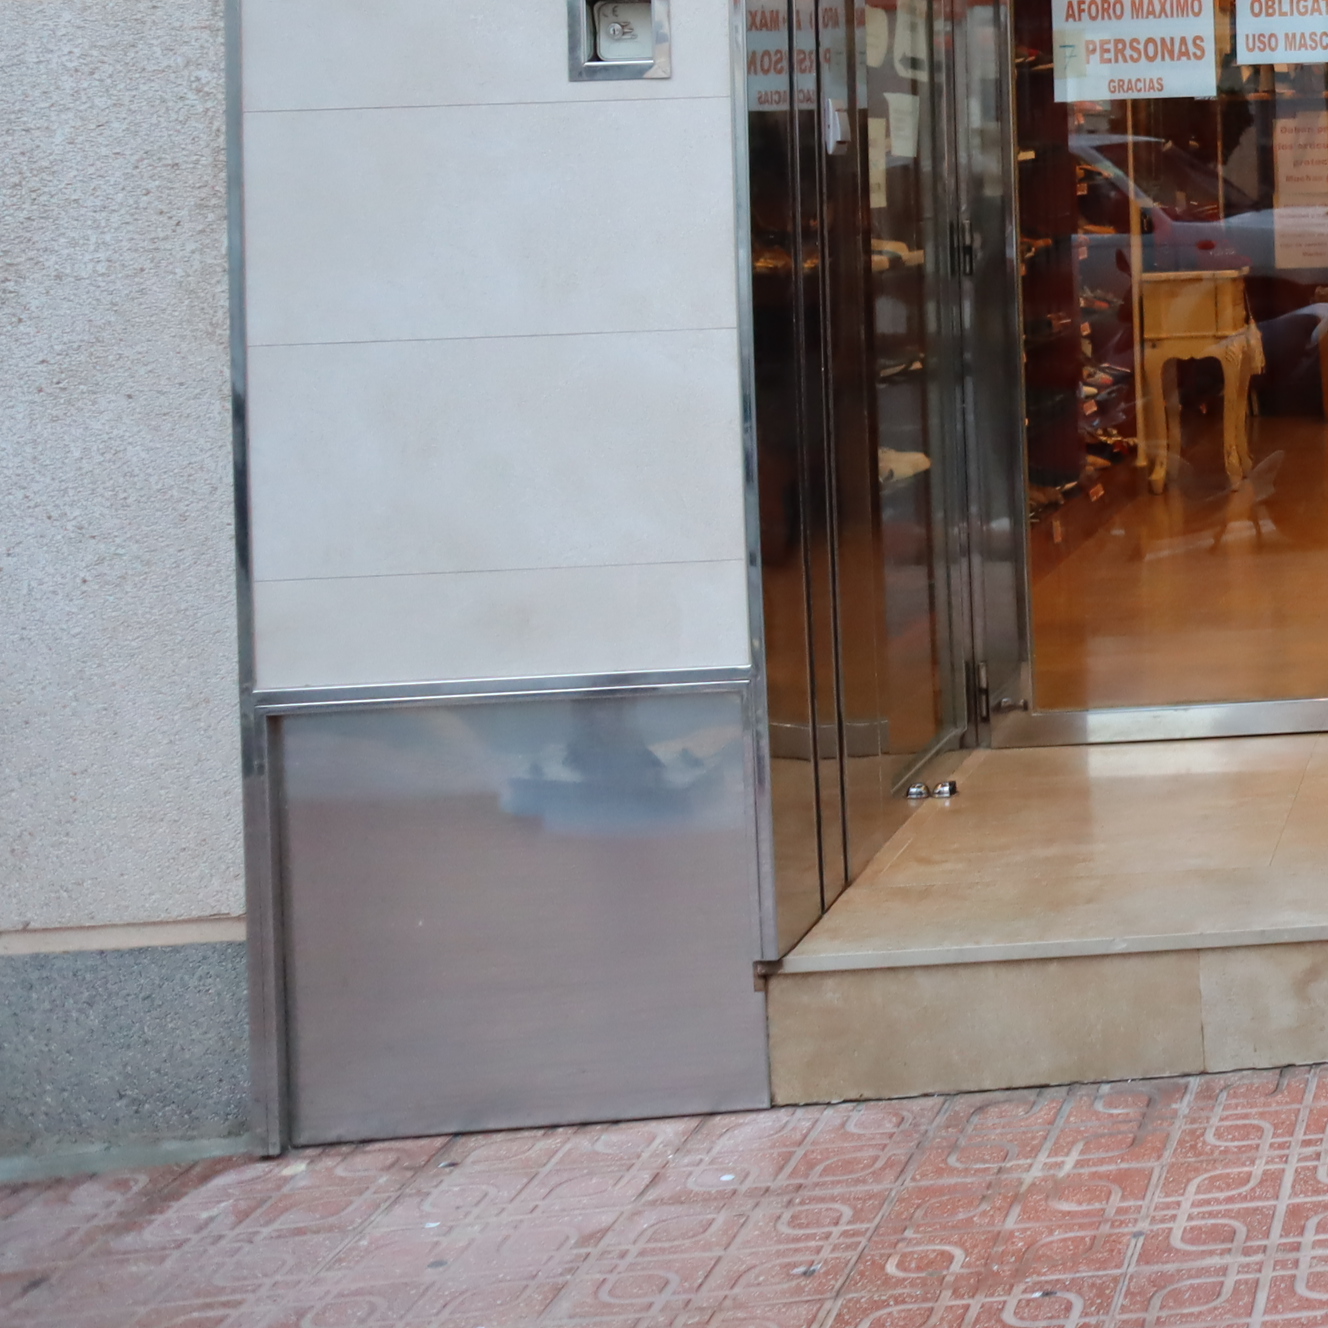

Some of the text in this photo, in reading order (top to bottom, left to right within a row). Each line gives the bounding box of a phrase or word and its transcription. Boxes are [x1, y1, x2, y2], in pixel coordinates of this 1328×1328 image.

[1084, 34, 1206, 65] PERSONAS
[1245, 32, 1279, 53] USO
[1107, 77, 1164, 94] GRACIAS
